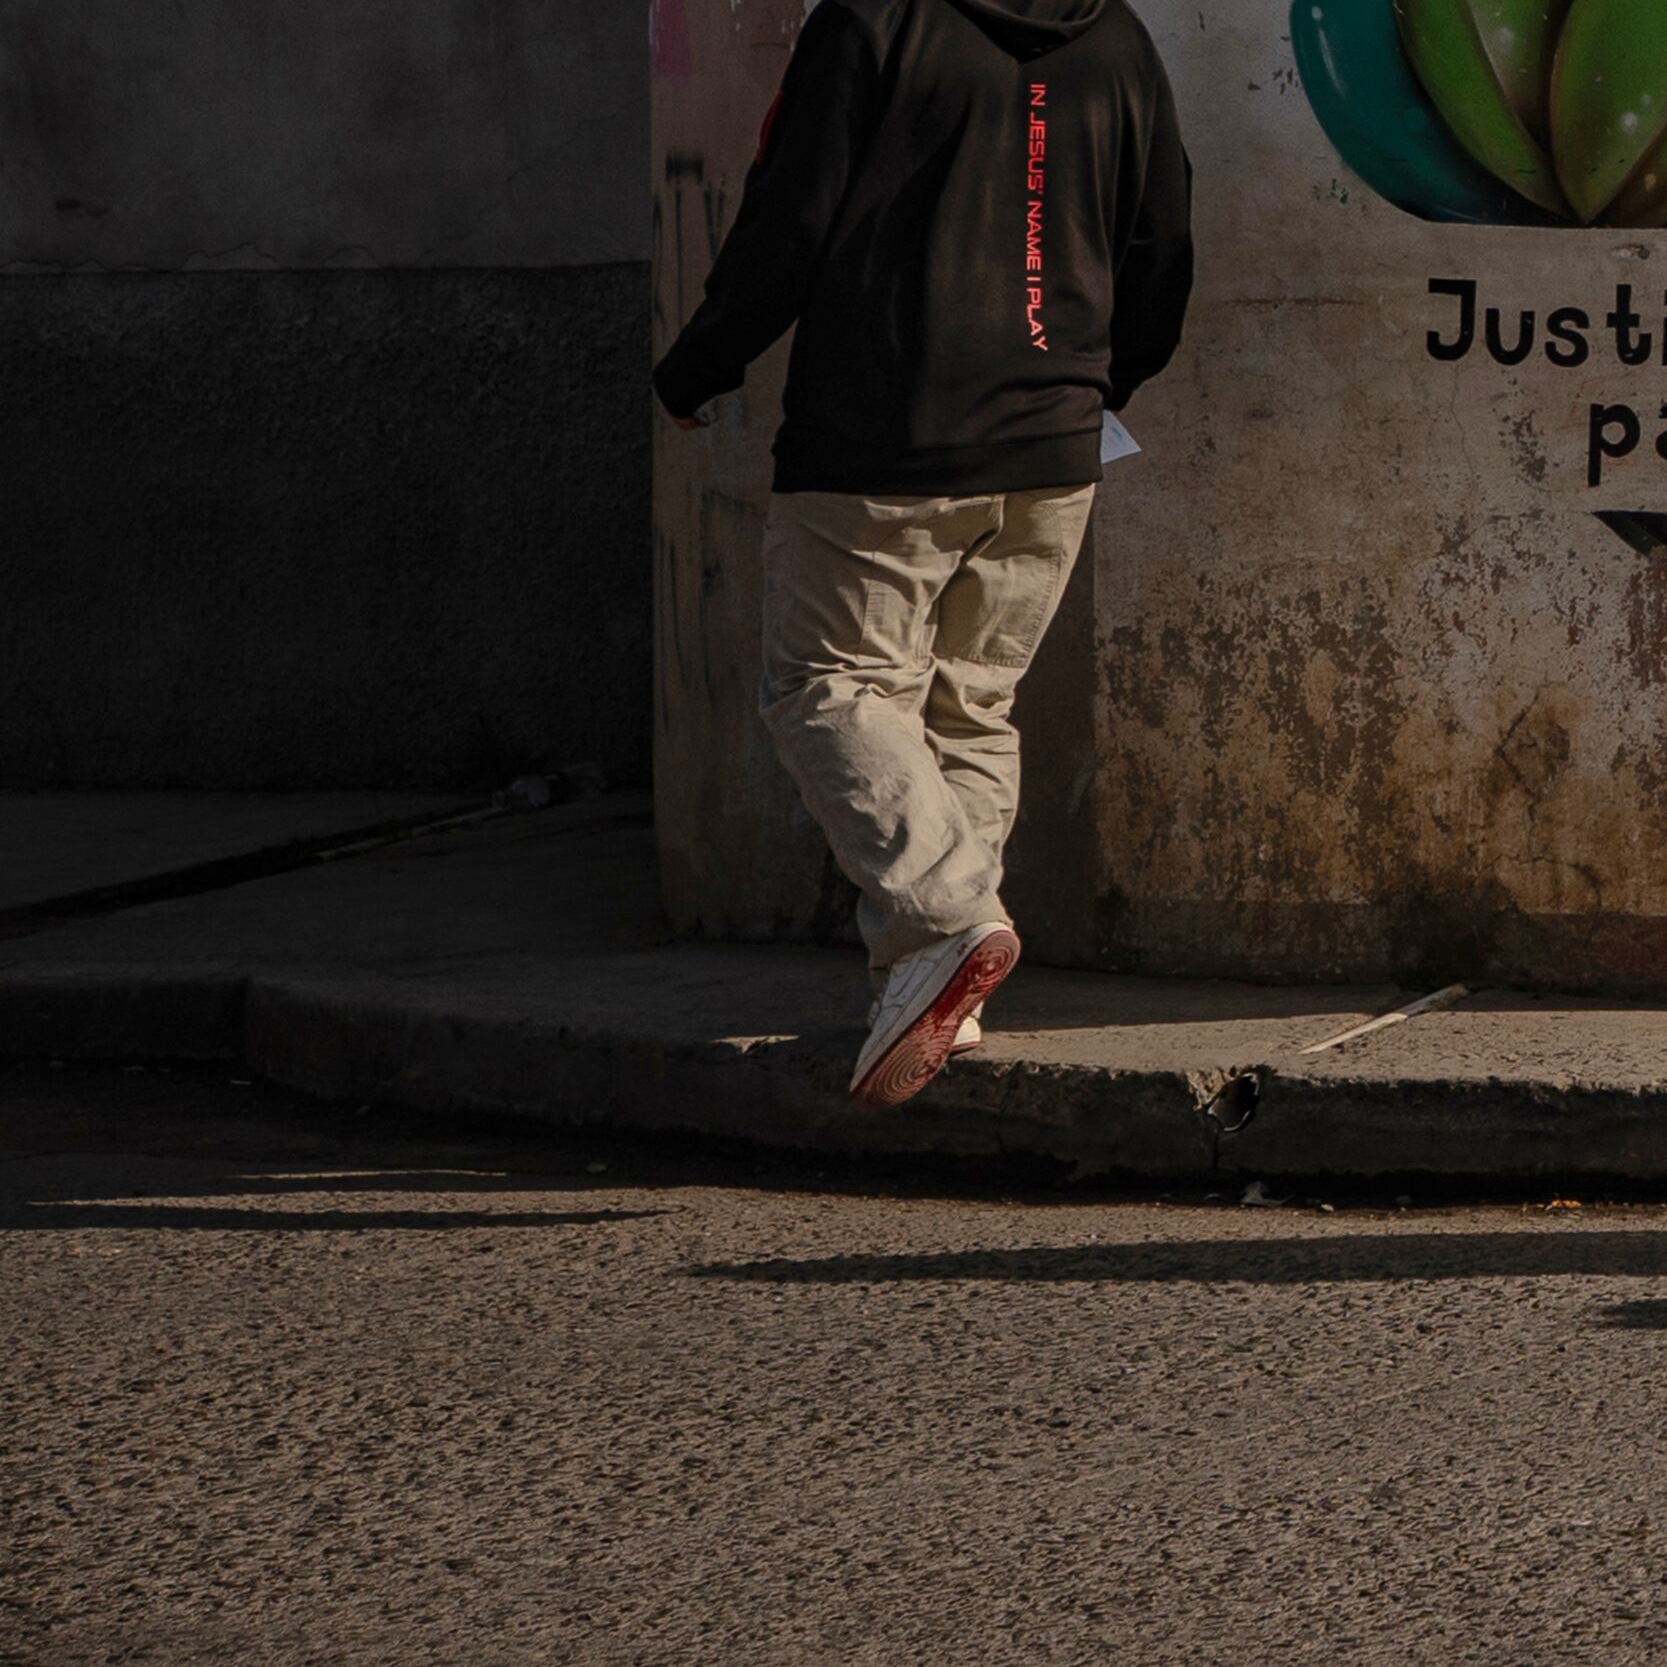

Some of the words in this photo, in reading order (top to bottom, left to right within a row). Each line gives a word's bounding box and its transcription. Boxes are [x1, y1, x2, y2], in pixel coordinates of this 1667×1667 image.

[1030, 83, 1046, 106] IN
[1026, 199, 1044, 271] NAME
[1026, 285, 1048, 351] PLAY
